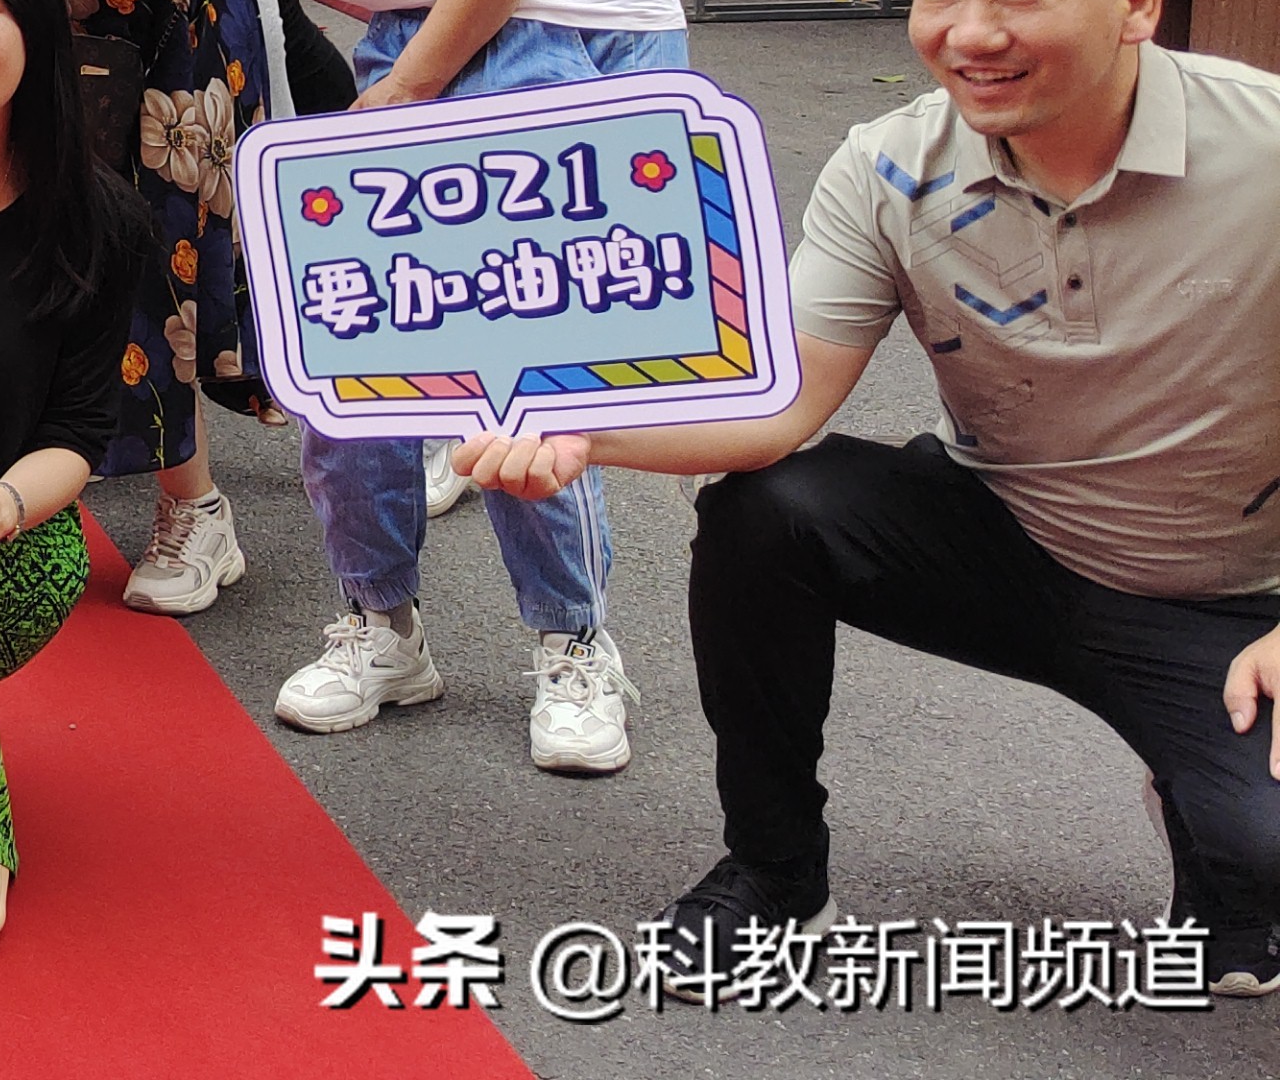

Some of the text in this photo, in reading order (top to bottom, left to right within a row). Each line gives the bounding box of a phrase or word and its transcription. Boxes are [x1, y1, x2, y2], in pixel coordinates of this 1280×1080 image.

[350, 140, 608, 238] 2021
[300, 222, 694, 340] 要加油鸭!
